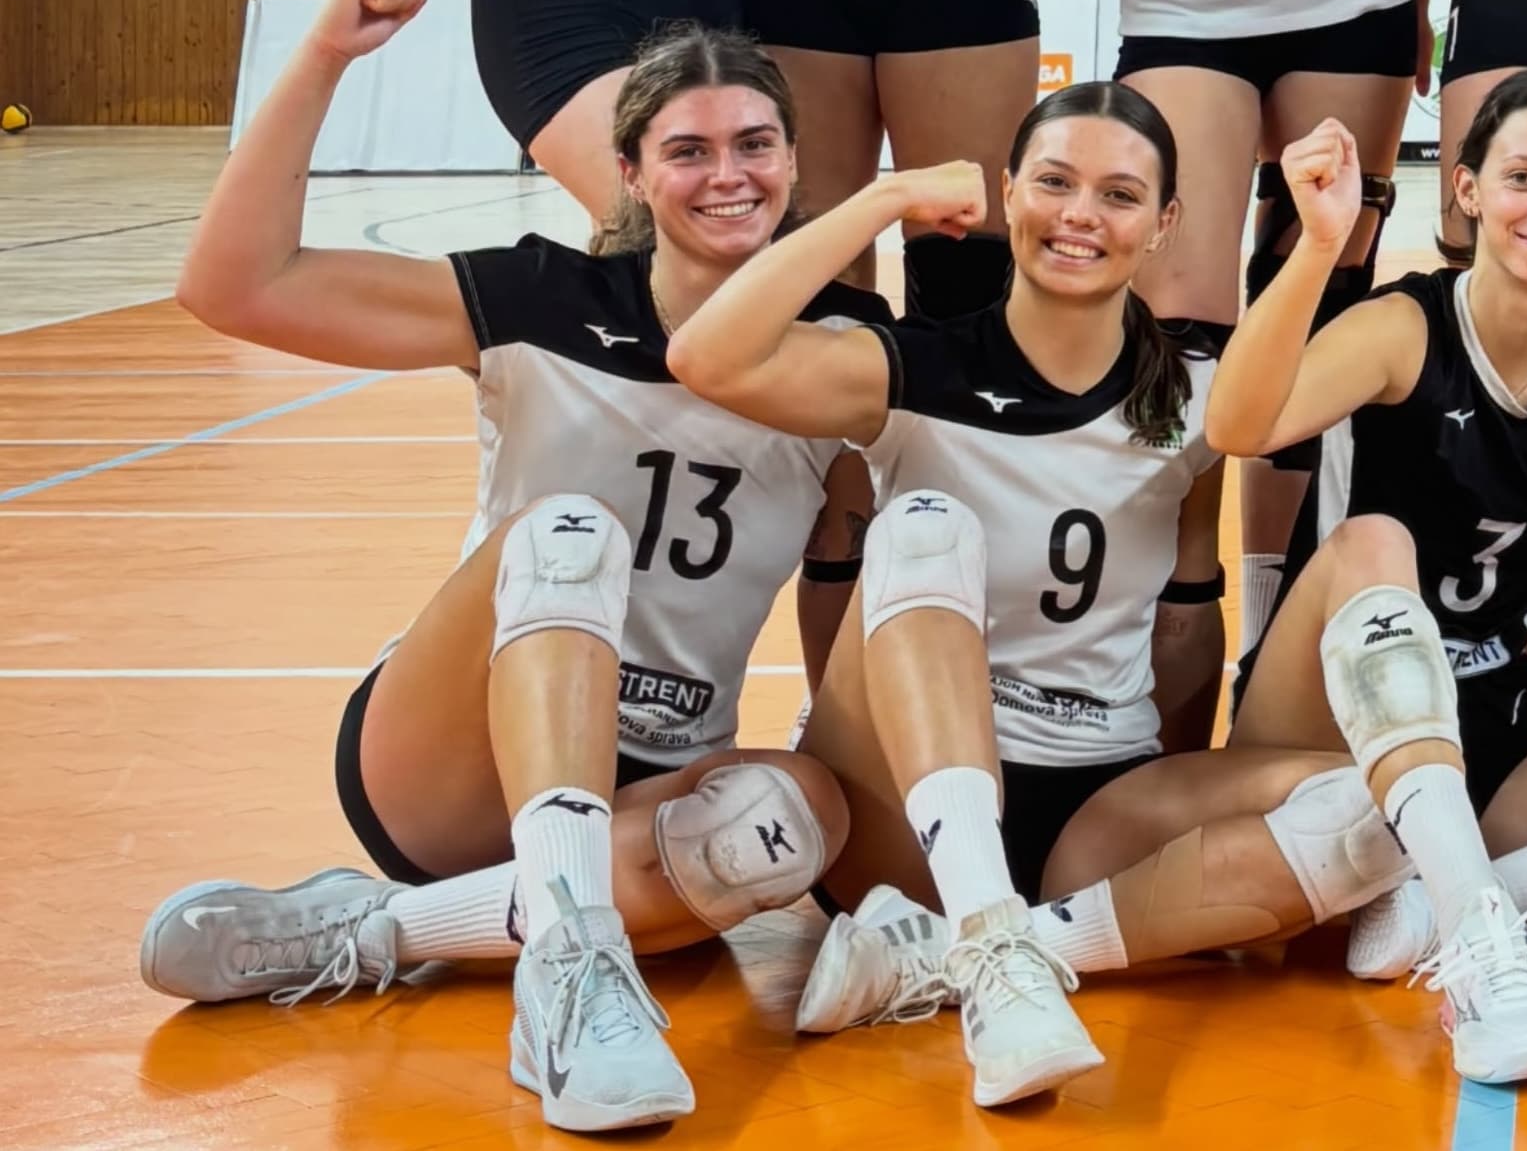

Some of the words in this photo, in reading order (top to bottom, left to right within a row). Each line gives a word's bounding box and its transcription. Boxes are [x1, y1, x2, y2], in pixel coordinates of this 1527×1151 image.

[633, 449, 742, 581] 13
[1040, 508, 1107, 624] 9
[1439, 518, 1527, 613] 3
